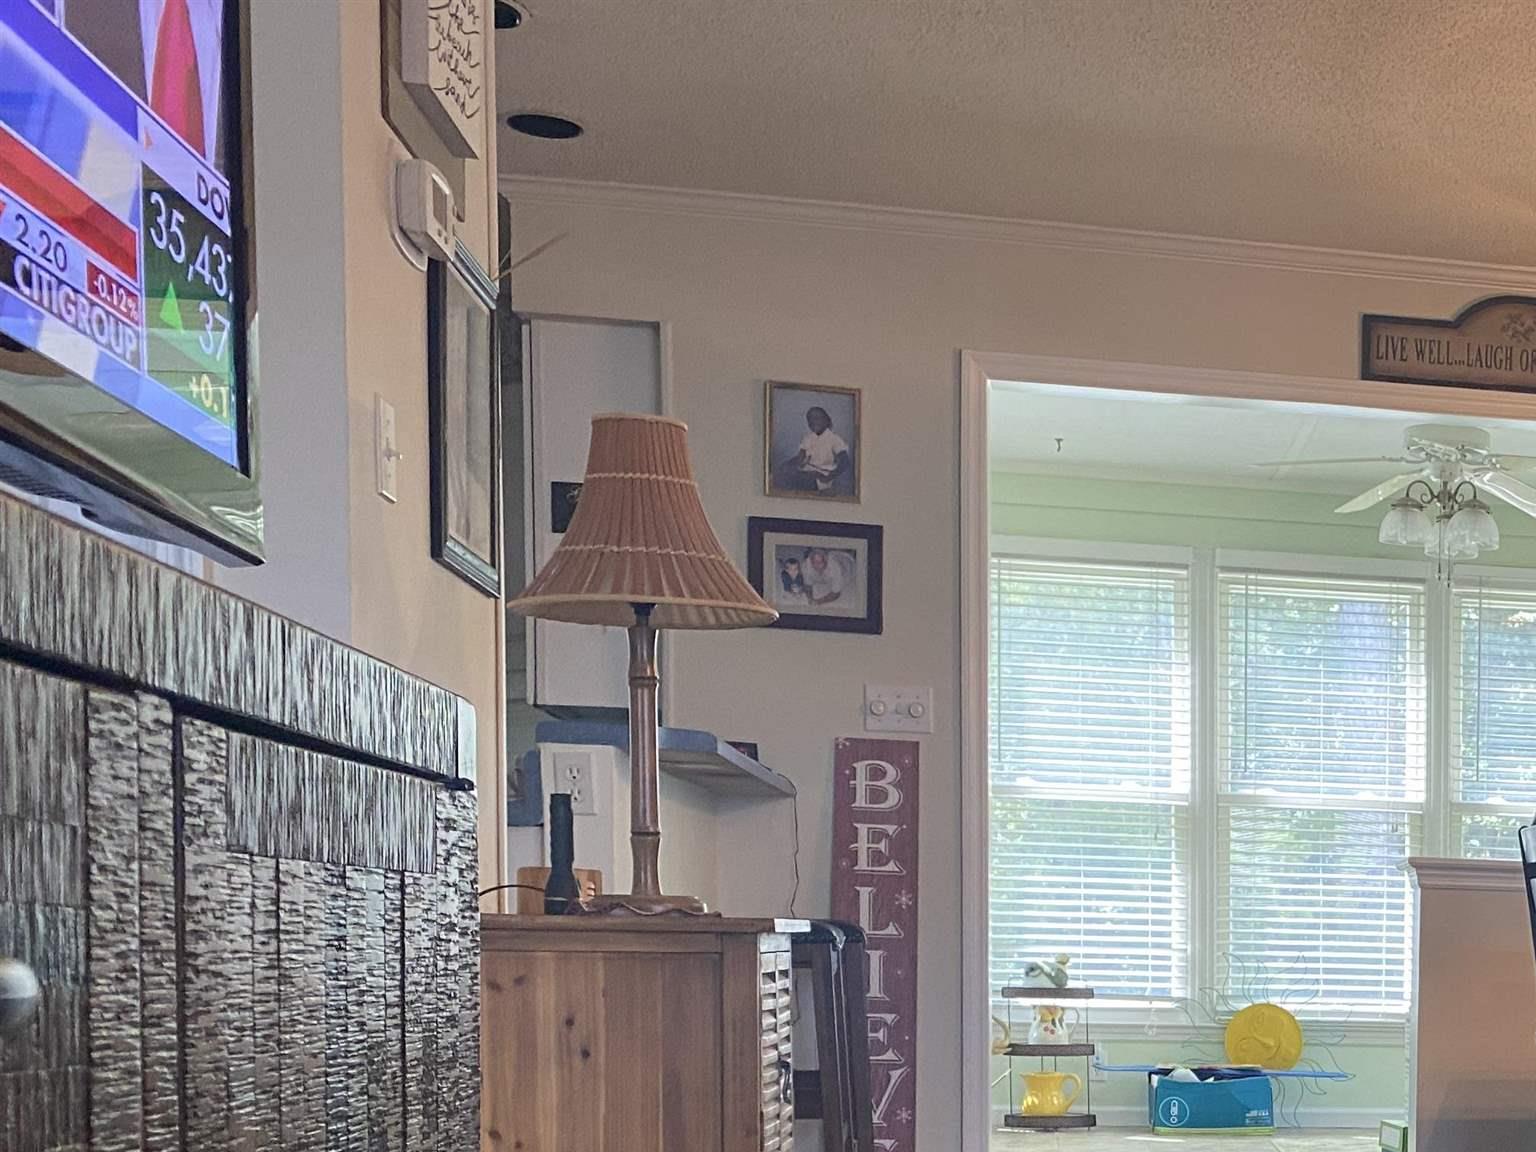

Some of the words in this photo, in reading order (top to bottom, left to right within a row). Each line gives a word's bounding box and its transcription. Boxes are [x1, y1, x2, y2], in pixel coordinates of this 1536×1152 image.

[197, 171, 231, 221] DO
[15, 213, 68, 273] 2.20
[150, 191, 233, 303] 35,43
[13, 253, 138, 361] CITIGROUP
[1376, 334, 1408, 362] LIVE
